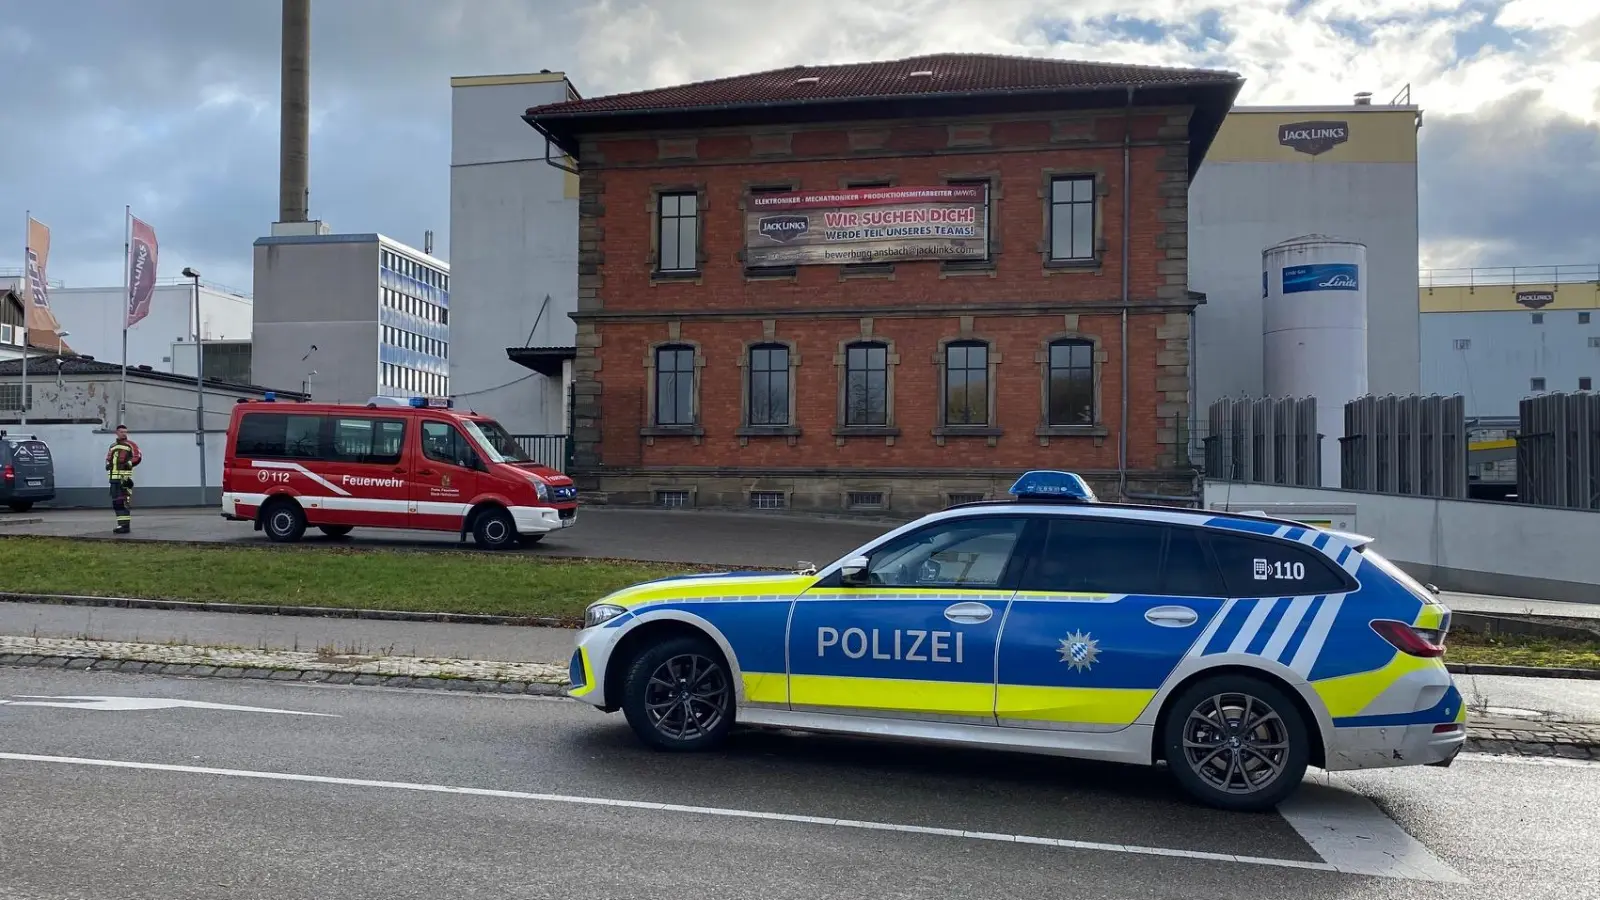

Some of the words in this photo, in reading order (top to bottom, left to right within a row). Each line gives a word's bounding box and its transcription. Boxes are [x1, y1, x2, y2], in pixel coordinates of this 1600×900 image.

[1282, 130, 1311, 141] JACK
[755, 197, 801, 205] ELEKTRONIKER
[805, 194, 859, 202] MECHATRONIKER
[863, 190, 952, 200] PRODUKTIONSMITARBEITER
[825, 213, 857, 227] WIR
[862, 209, 926, 225] SUCHEN
[930, 207, 974, 222] DICH!
[762, 222, 781, 231] JACK
[825, 230, 861, 240] WERDE
[864, 229, 883, 237] TEIL
[886, 226, 932, 236] UNSERES
[934, 225, 974, 235] TEAMS!
[1318, 274, 1357, 287] Linde
[271, 472, 290, 482] 112
[342, 474, 404, 488] Feuerwehr
[1274, 560, 1305, 580] 110
[818, 626, 963, 663] POLIZEI
